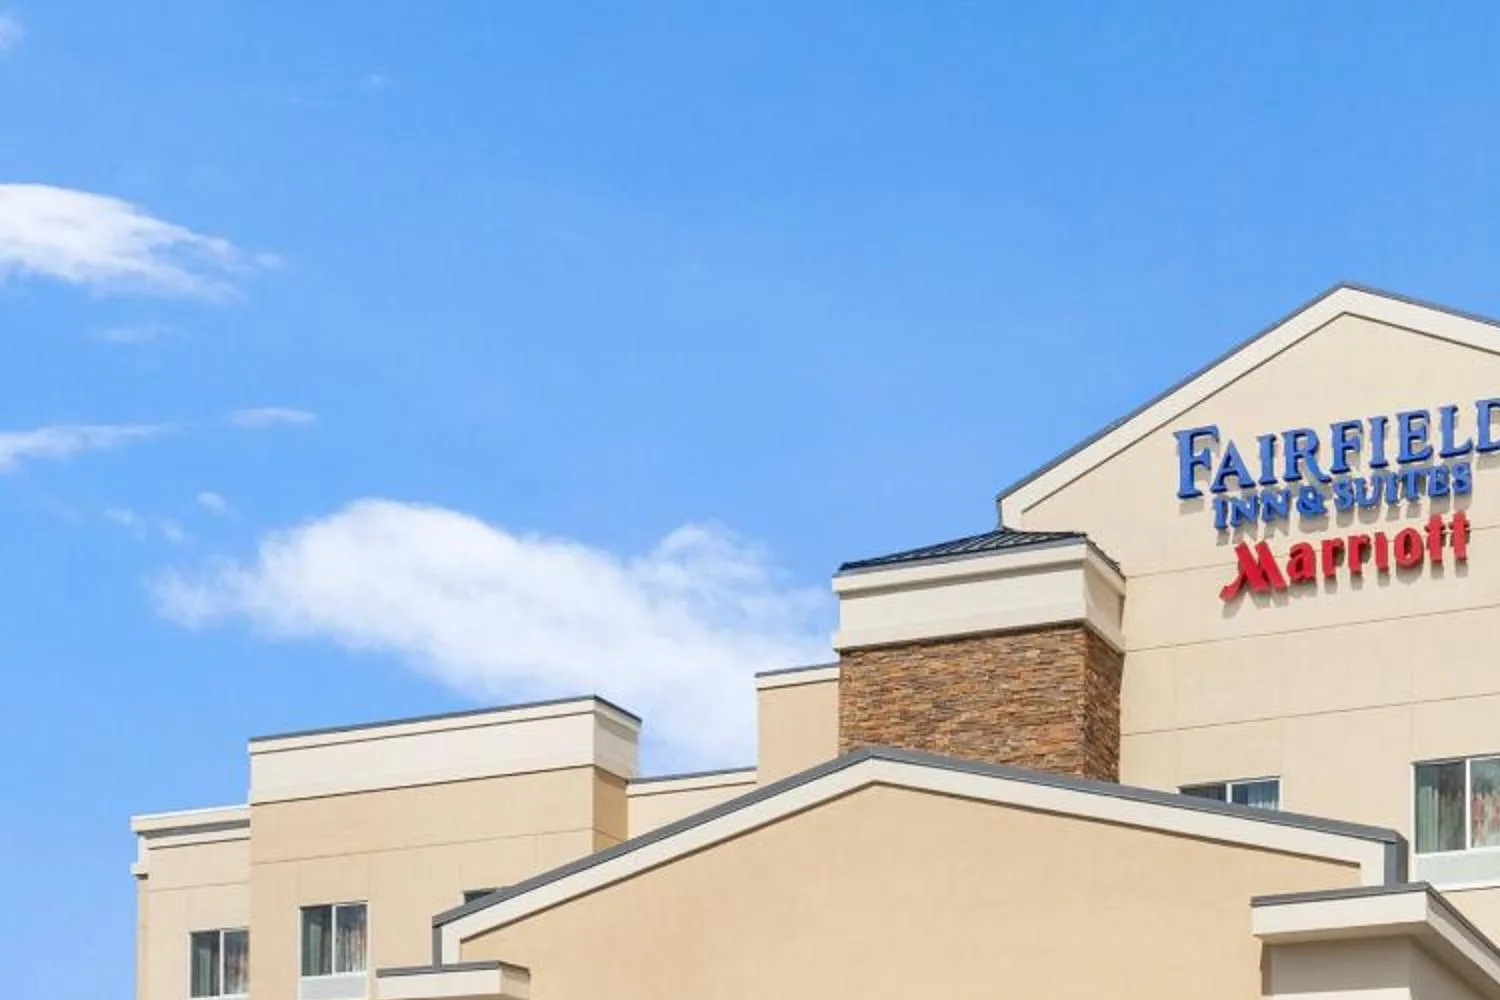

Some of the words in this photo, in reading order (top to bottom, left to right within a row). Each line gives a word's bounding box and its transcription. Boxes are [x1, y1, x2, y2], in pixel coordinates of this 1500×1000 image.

[1212, 487, 1292, 530] INN
[1294, 485, 1328, 516] &
[1330, 462, 1475, 510] SUITES
[1219, 510, 1471, 600] Marriott
